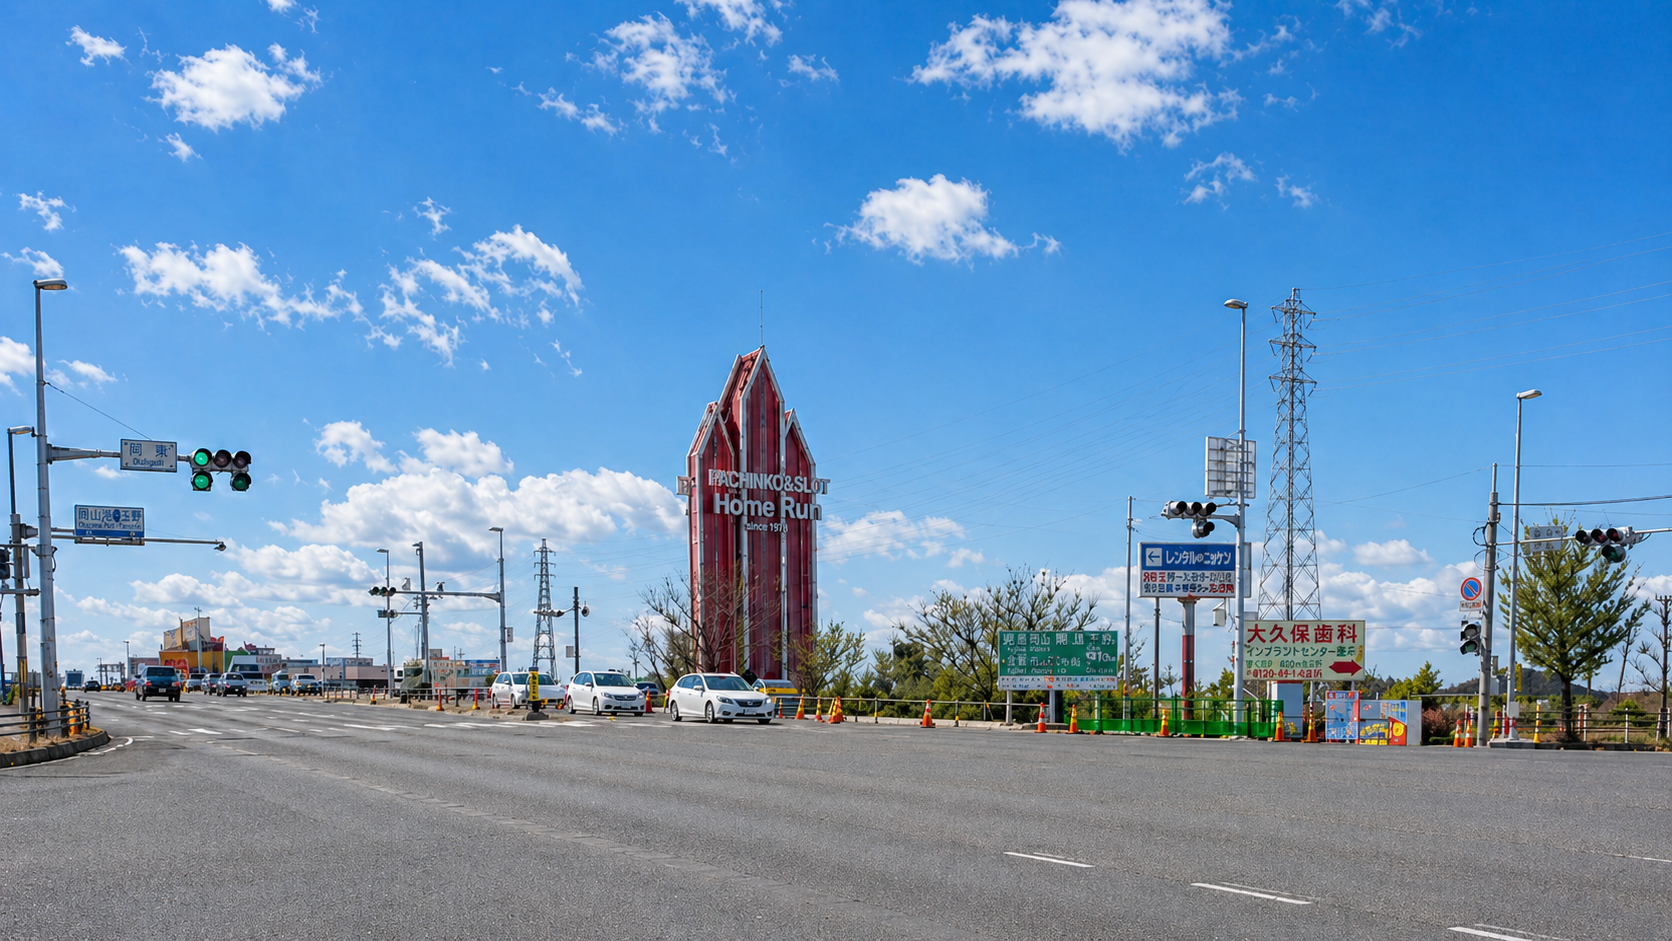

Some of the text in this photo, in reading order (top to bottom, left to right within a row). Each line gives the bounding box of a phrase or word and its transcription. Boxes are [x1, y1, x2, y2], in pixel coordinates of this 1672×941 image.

[713, 493, 822, 520] Home Run
[1247, 623, 1358, 644] 大久保歯科
